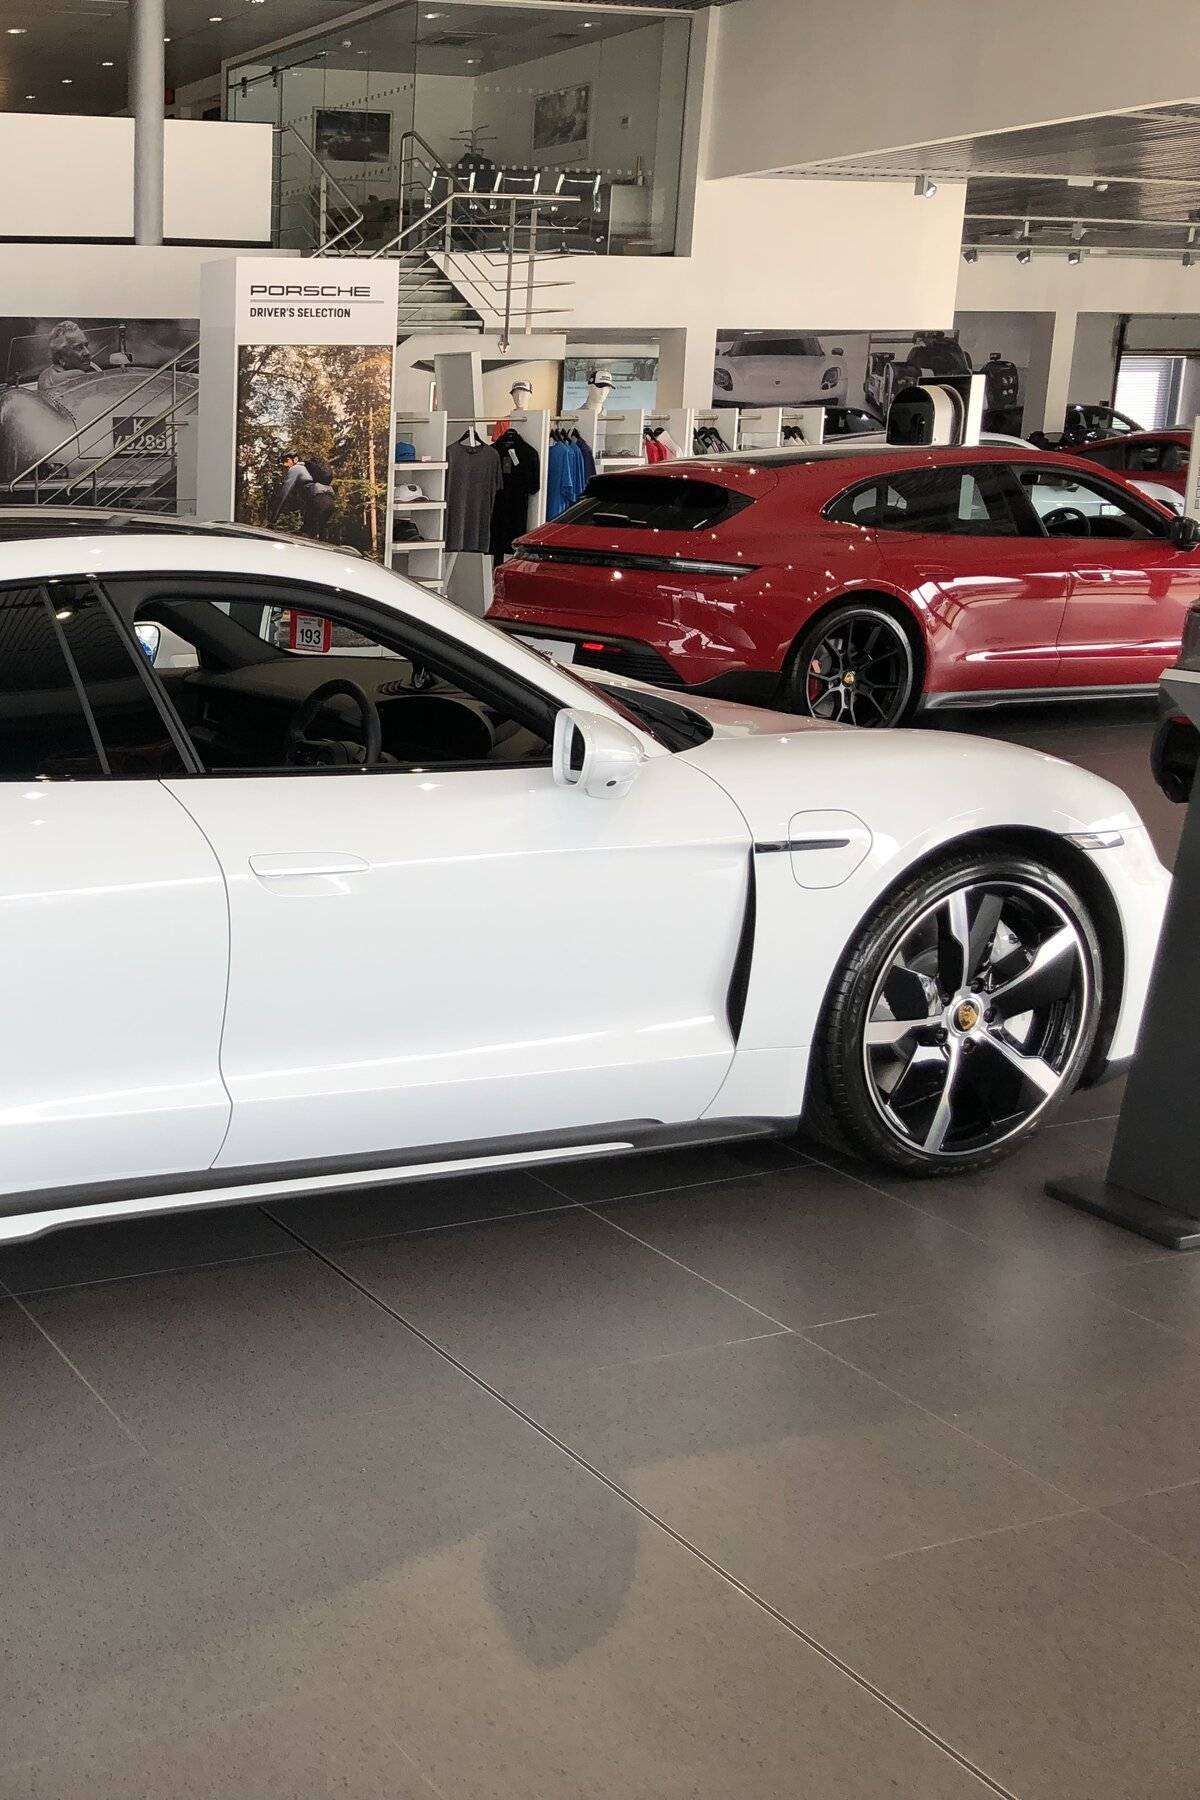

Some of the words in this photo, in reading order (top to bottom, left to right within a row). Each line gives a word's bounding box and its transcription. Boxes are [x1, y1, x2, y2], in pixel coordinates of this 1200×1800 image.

[250, 285, 371, 297] PORSCHE
[249, 307, 295, 318] DRIVER'S
[297, 307, 352, 318] SELECTION
[300, 628, 321, 644] 193
